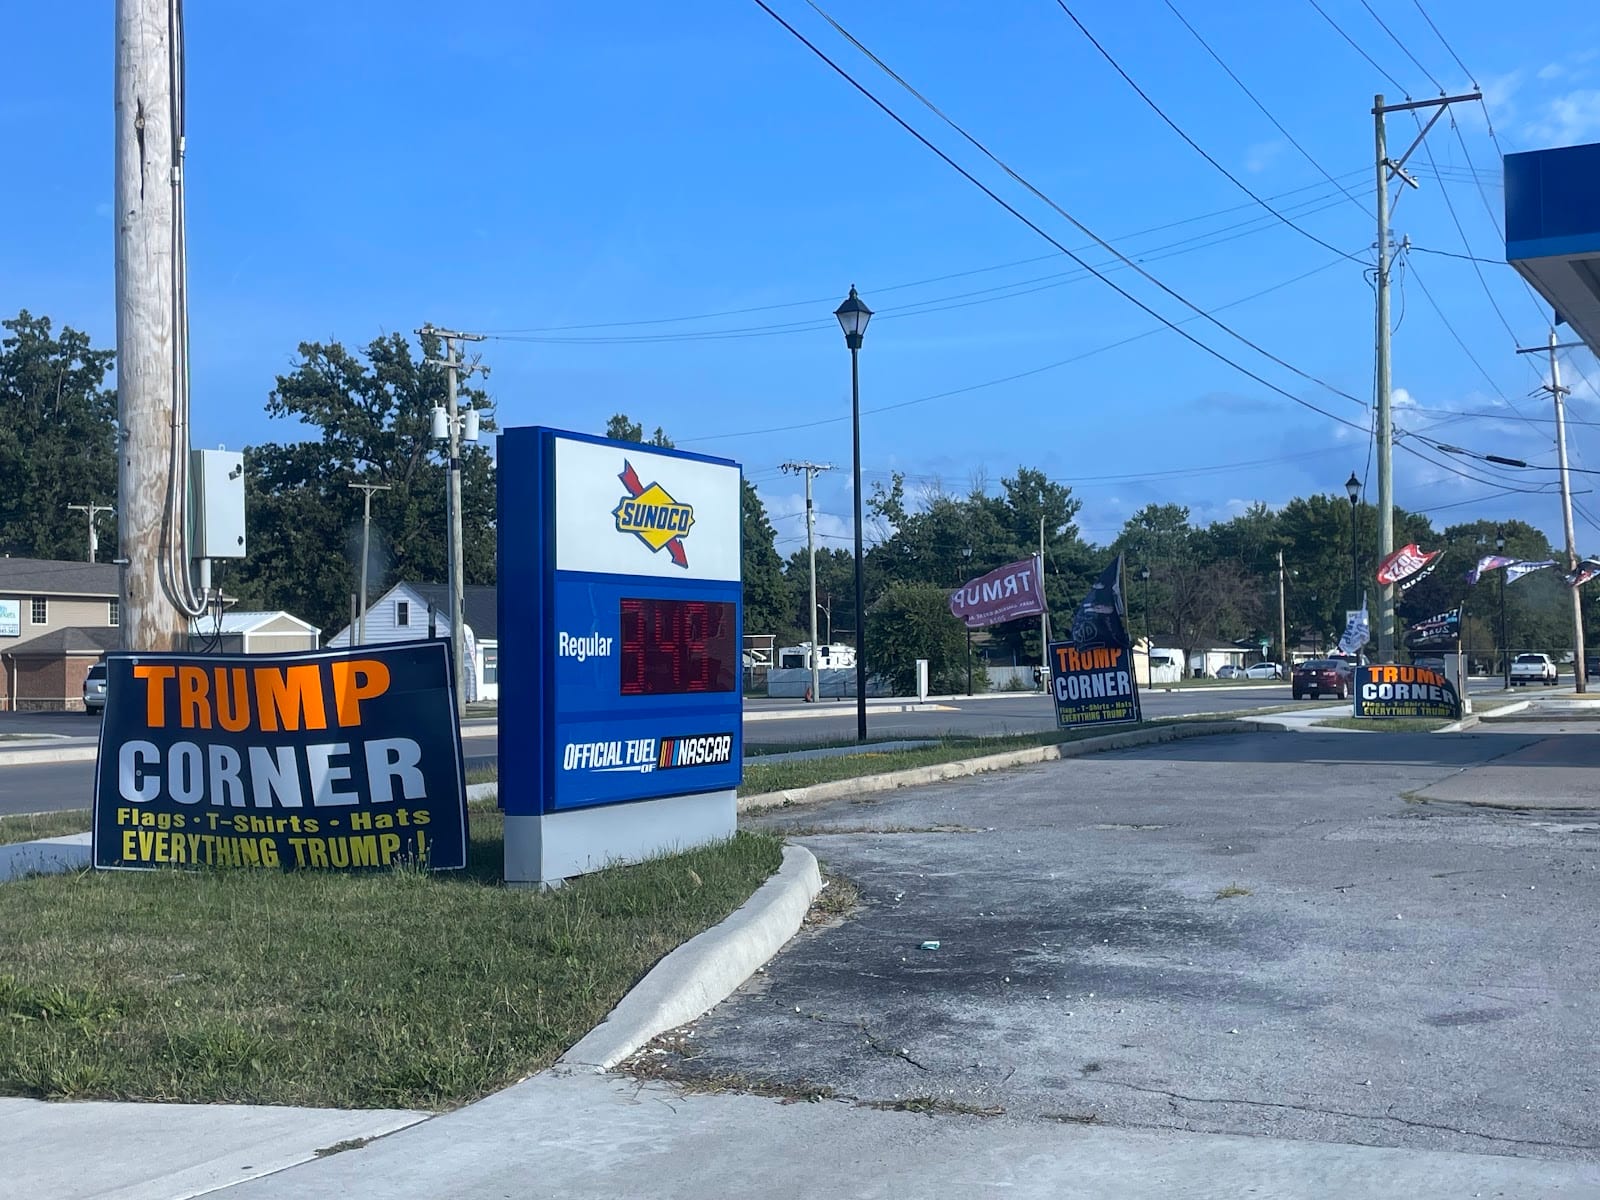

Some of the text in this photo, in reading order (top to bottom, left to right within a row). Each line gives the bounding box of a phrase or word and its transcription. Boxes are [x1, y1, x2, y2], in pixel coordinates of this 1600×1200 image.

[622, 501, 690, 532] SUNOCO
[559, 631, 613, 664] Regular
[1056, 647, 1122, 673] TRUMP
[1055, 670, 1131, 701] CORNER
[1367, 666, 1446, 687] TRUMP
[133, 659, 391, 732] TRUMP
[1362, 683, 1455, 704] CORNER
[1061, 711, 1100, 723] EVERYTHING
[1102, 708, 1127, 720] TRUMP
[1364, 707, 1417, 716] EVERYTHING
[1421, 707, 1451, 716] TRUMP
[563, 738, 657, 771] OFFICIAL FUEL
[677, 735, 731, 766] NASCAR
[118, 737, 428, 808] CORNER
[640, 763, 657, 774] OF
[117, 807, 431, 833] Flags T-Shirts Hats
[123, 830, 427, 868] EVERYTHING TRUMP !
